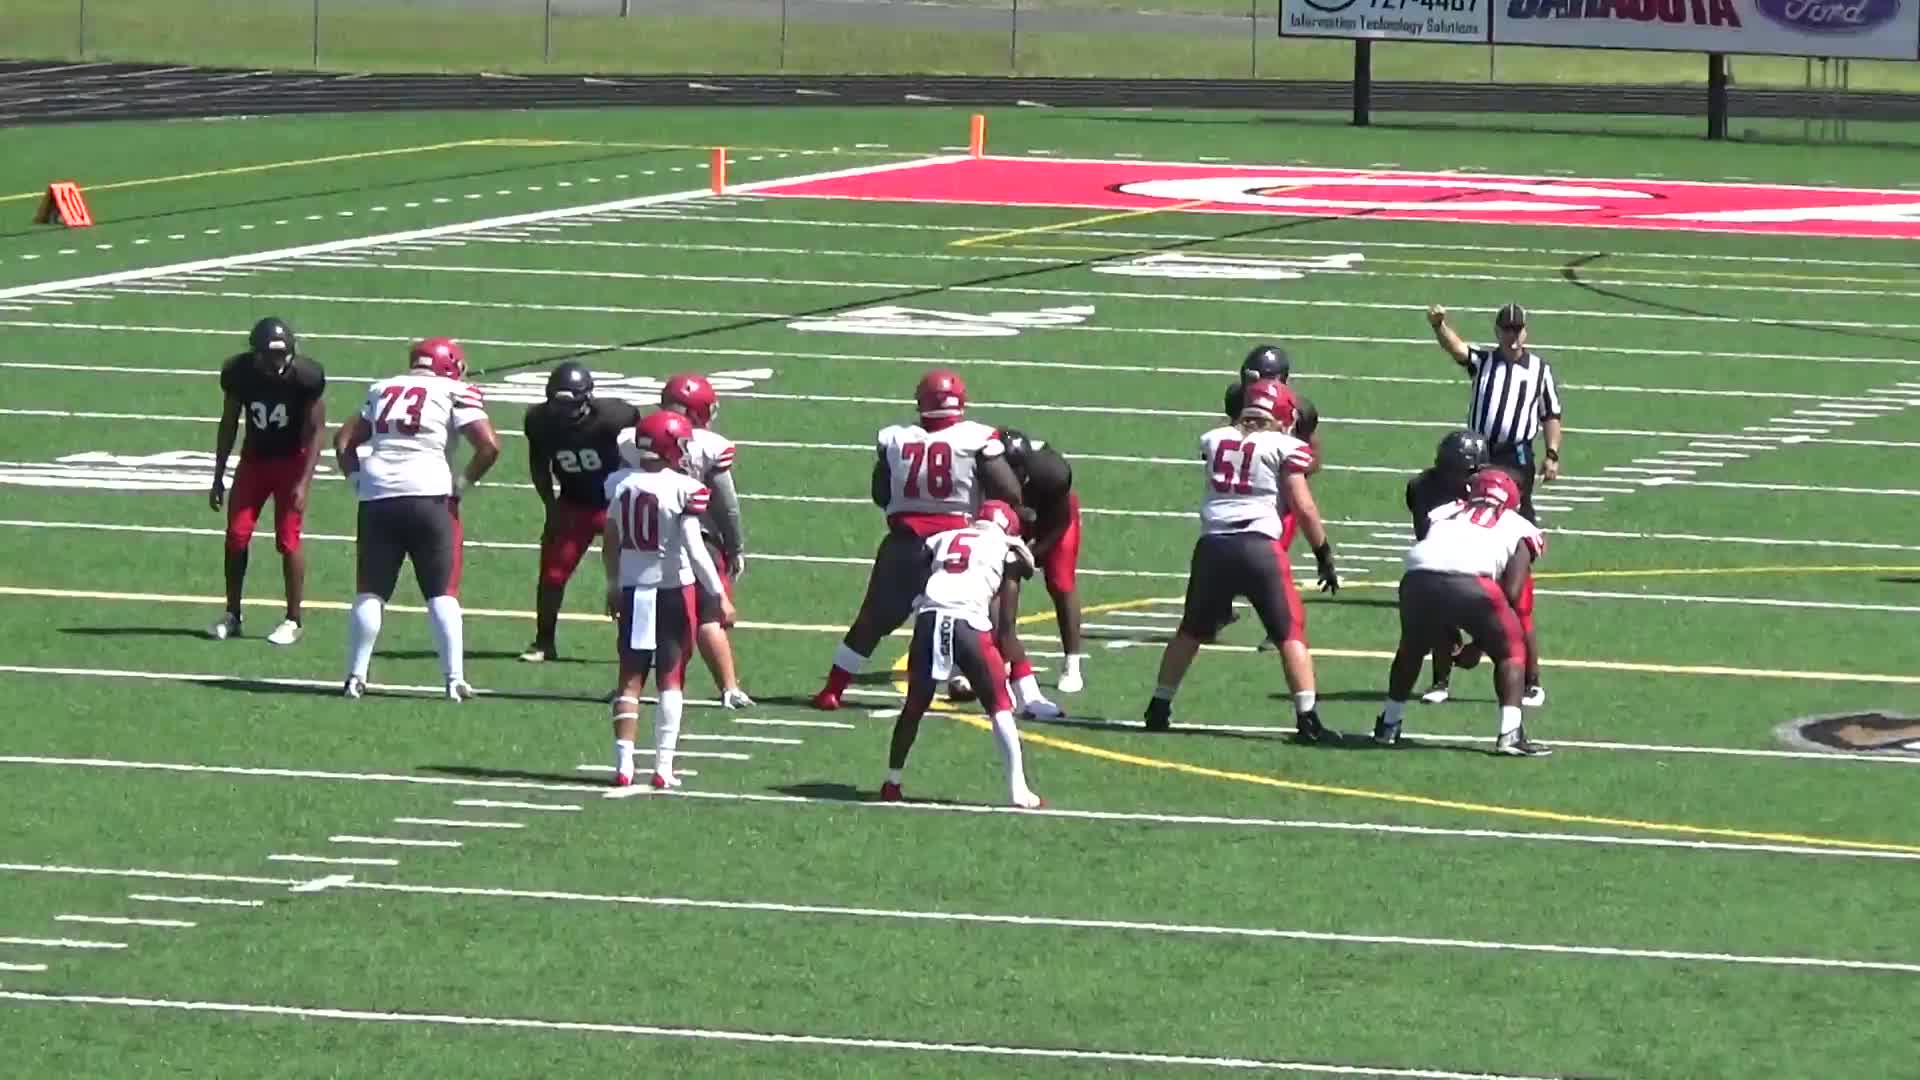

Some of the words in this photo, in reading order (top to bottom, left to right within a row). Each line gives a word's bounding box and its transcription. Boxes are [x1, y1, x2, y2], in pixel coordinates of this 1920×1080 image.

[1360, 15, 1424, 36] Technology
[251, 401, 289, 430] 34
[376, 386, 427, 436] 73
[557, 448, 602, 472] 28
[902, 441, 953, 498] 78
[1211, 439, 1256, 495] 51
[620, 487, 659, 552] 10
[944, 533, 980, 574] 5
